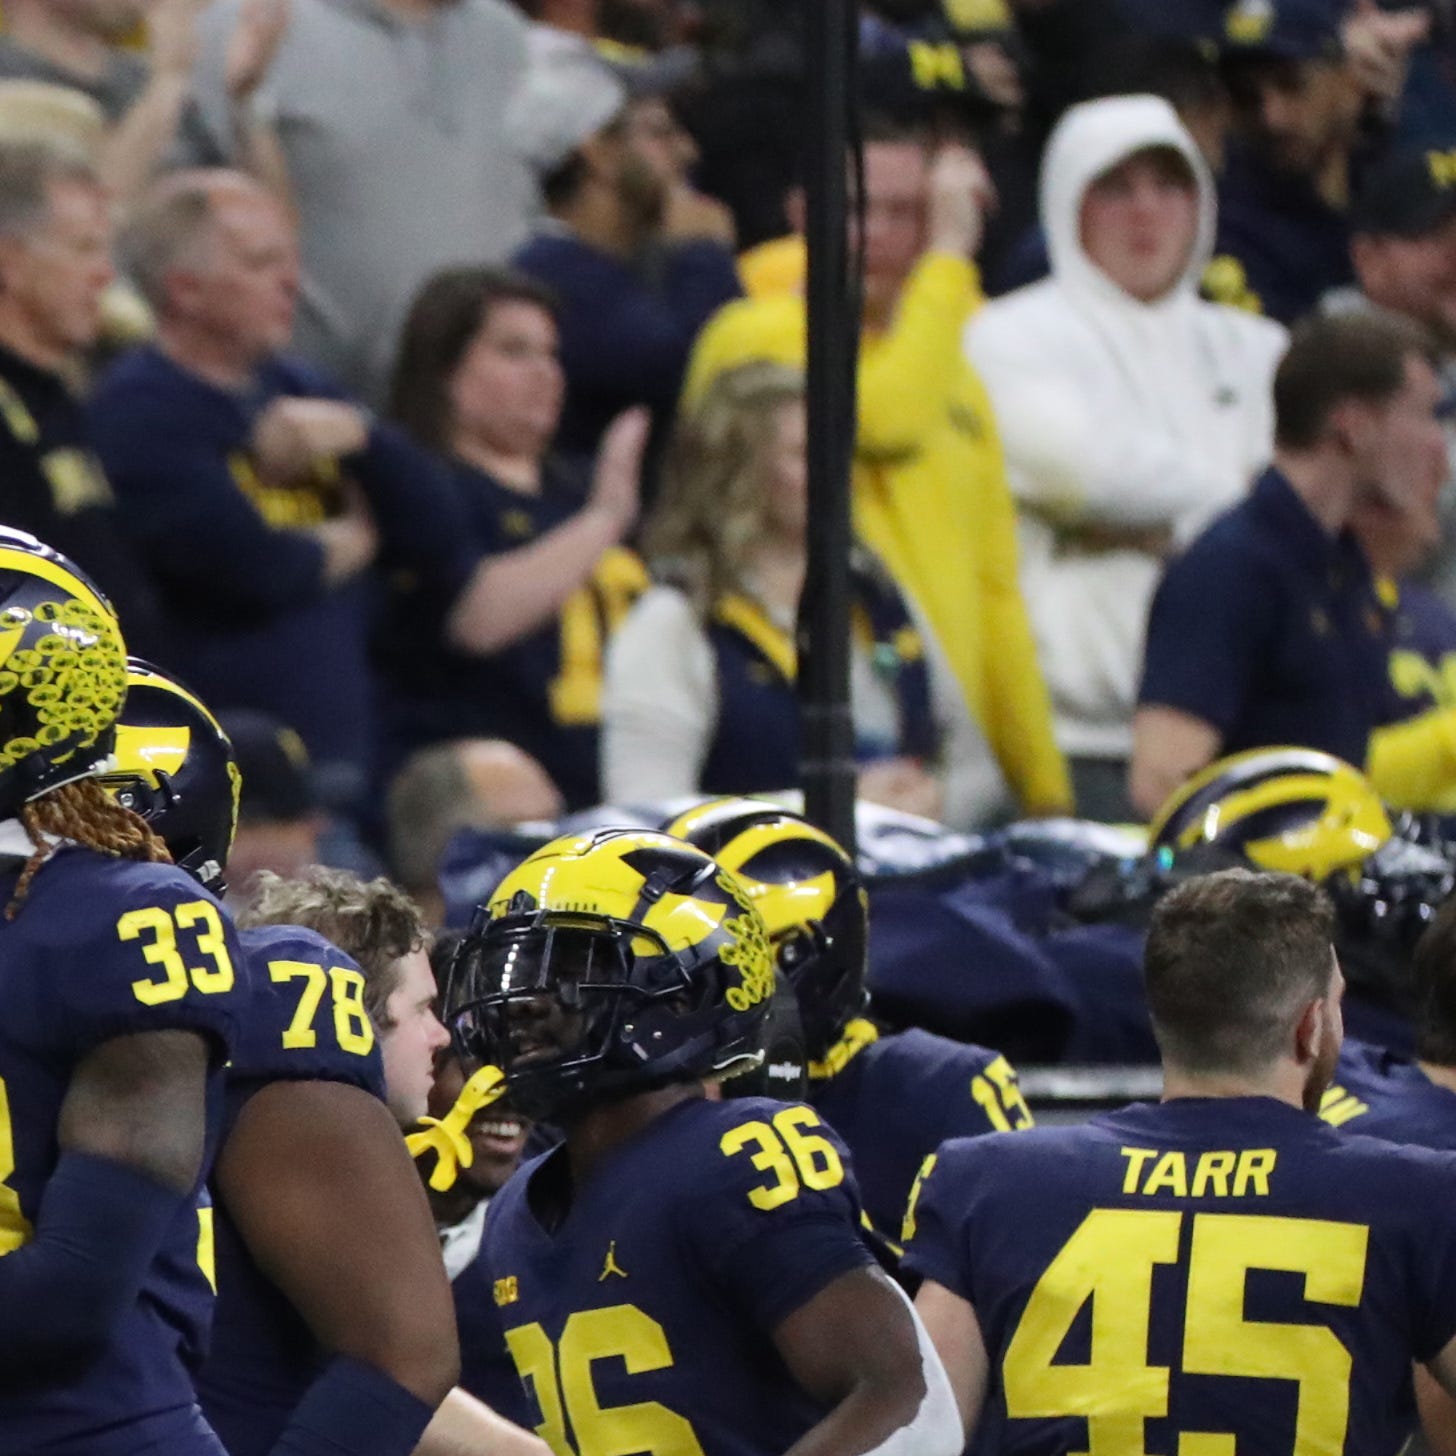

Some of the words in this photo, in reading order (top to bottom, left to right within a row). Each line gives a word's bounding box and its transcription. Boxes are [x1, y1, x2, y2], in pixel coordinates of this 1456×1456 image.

[117, 900, 235, 1005] 33
[268, 961, 374, 1055] 78
[721, 1105, 844, 1211] 36
[1120, 1147, 1277, 1197] TARR
